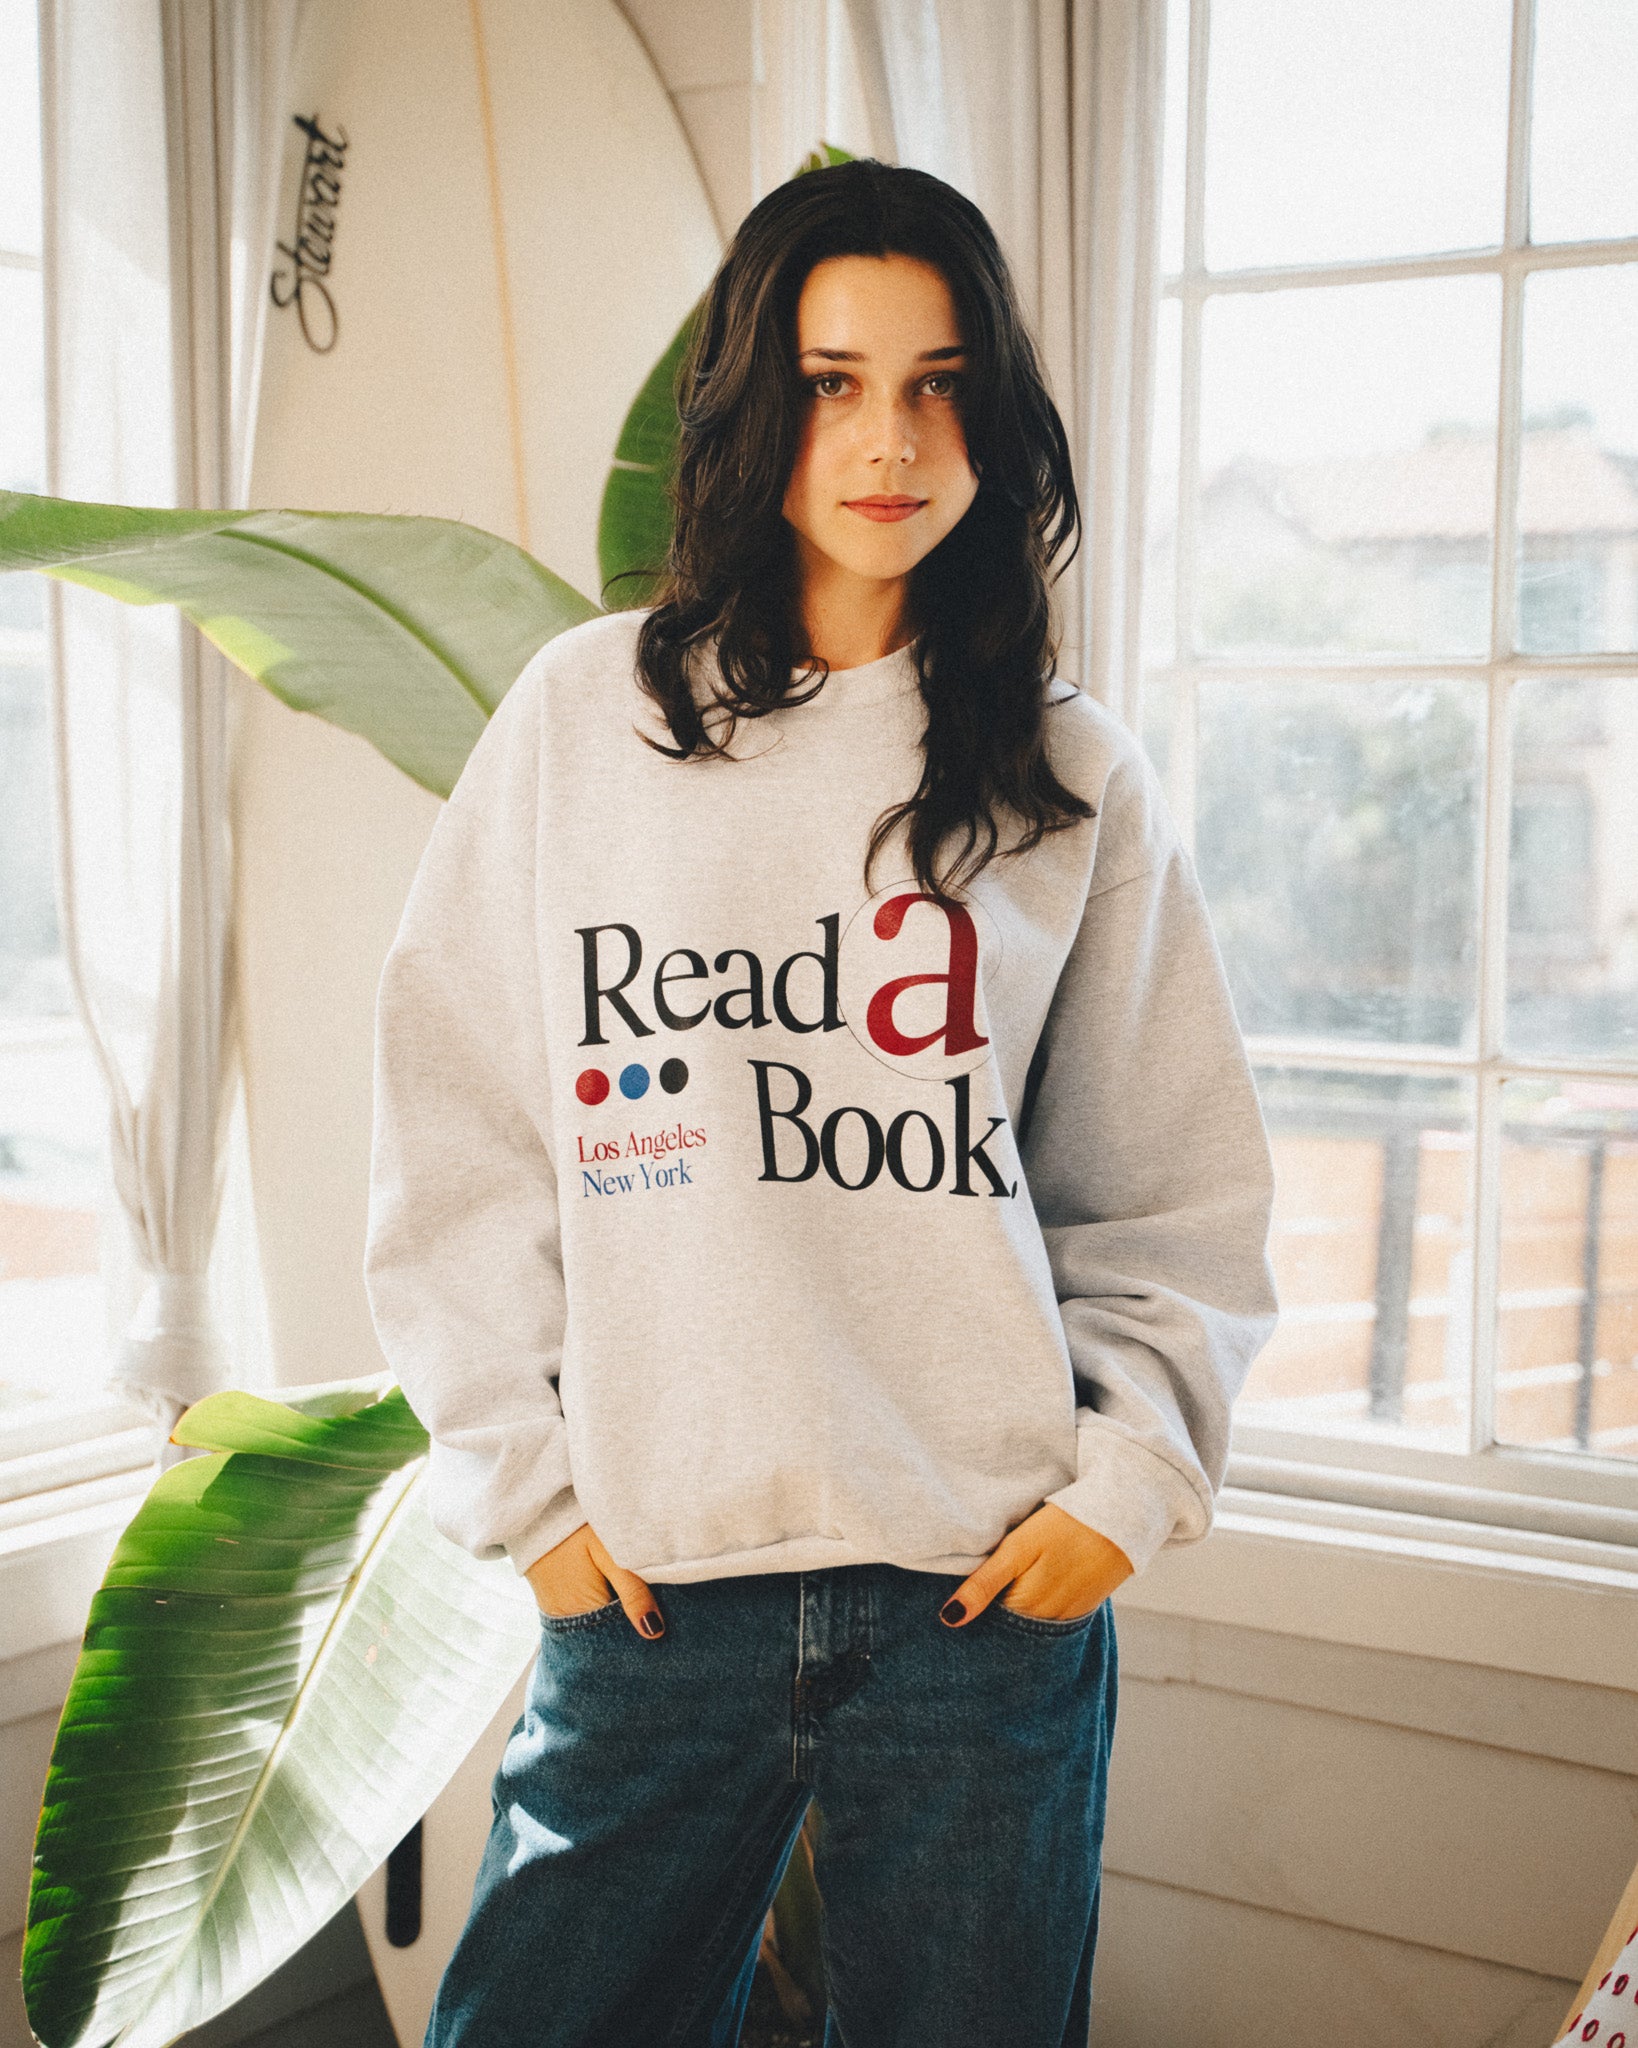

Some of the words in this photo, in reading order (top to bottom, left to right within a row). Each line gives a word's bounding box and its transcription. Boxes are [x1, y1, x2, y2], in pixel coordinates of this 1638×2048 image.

[270, 112, 348, 355] Stewart
[574, 912, 847, 1047] Read
[866, 892, 990, 1057] a
[577, 1135, 620, 1163] Los
[625, 1122, 707, 1160] Angeles
[582, 1169, 636, 1198] New
[639, 1158, 694, 1190] York
